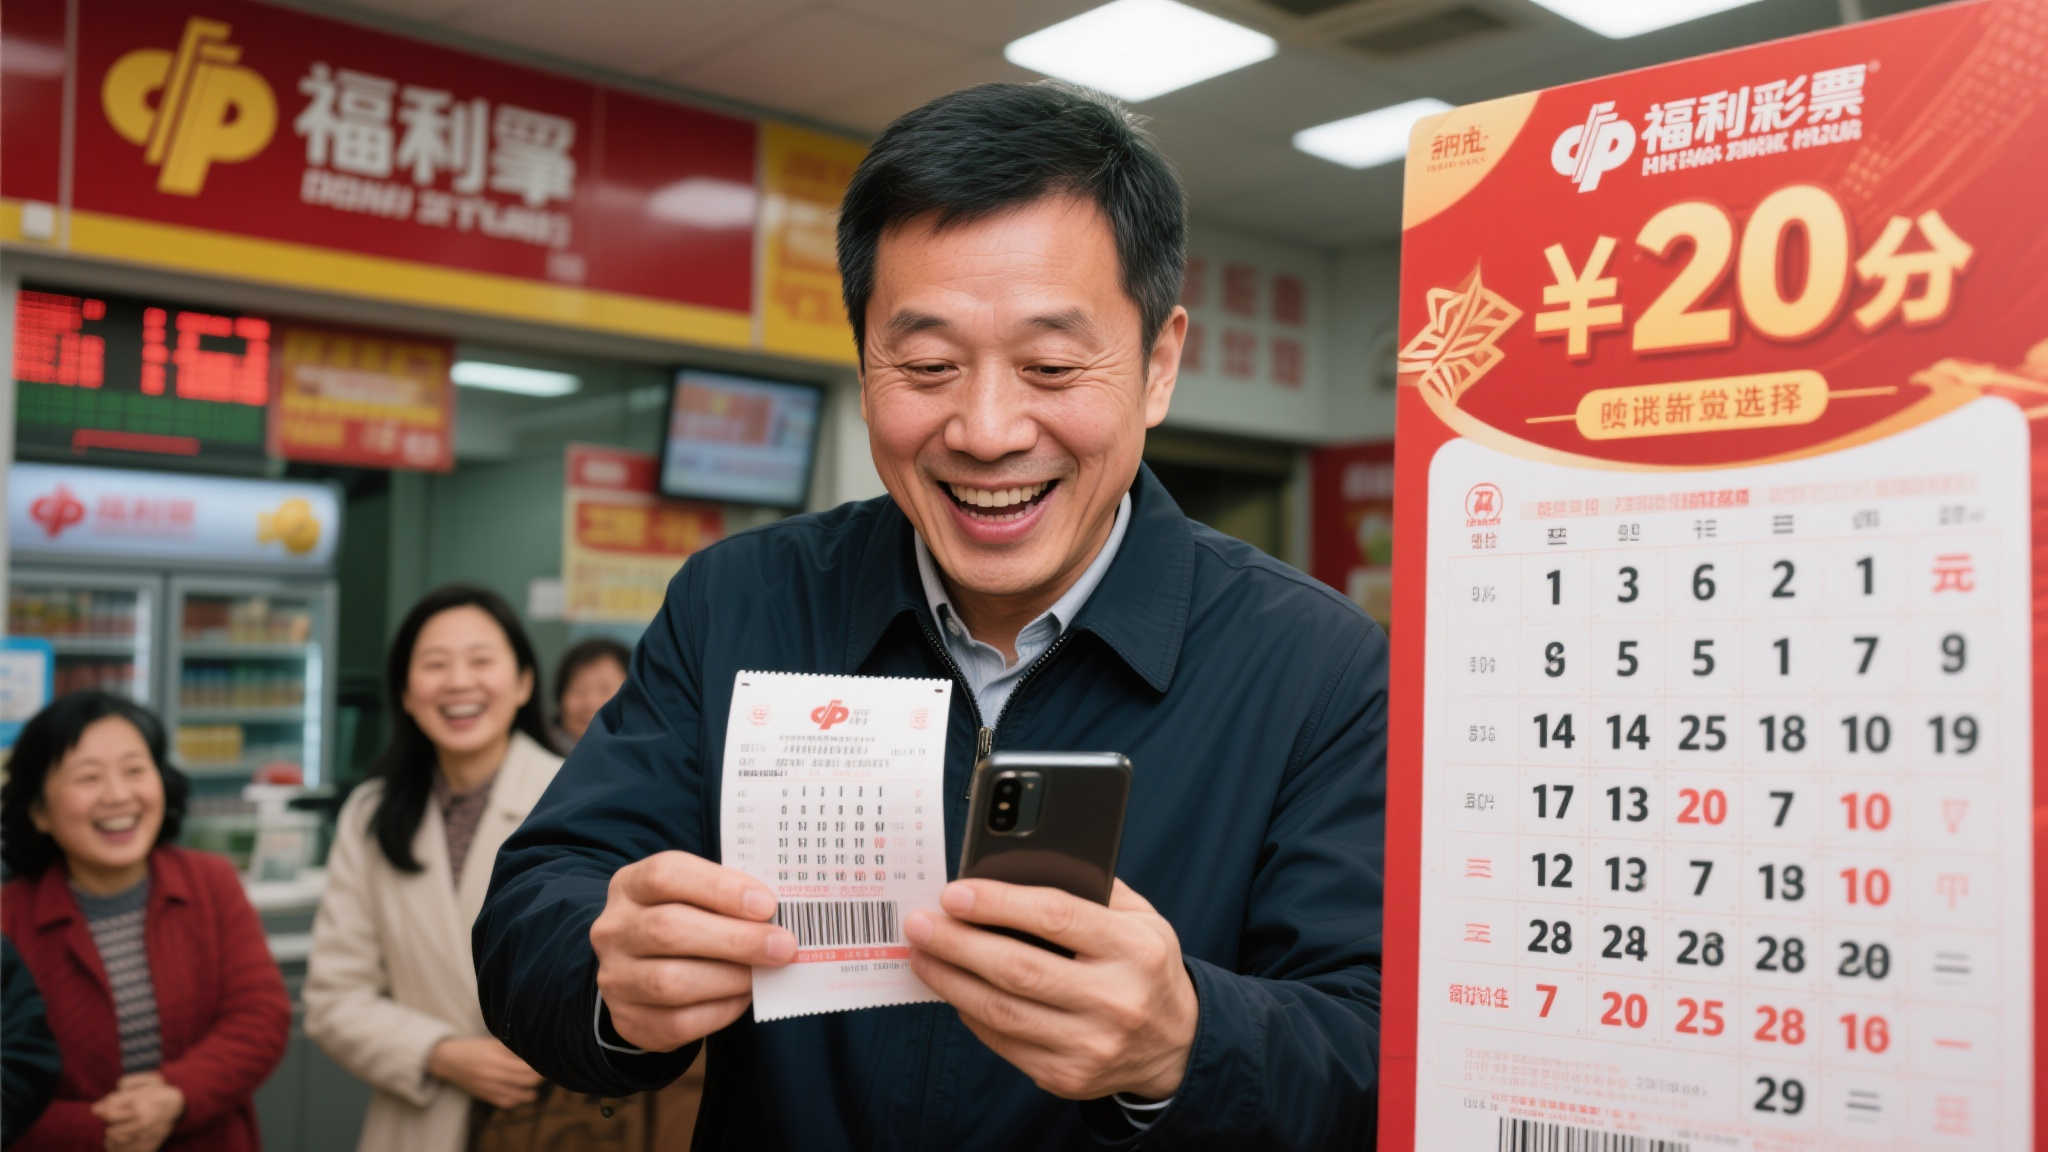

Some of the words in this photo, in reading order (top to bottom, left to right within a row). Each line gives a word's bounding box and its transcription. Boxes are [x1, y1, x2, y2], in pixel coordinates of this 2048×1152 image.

[1641, 63, 1868, 155] 福利彩票
[1546, 569, 1561, 606] 1
[1617, 566, 1639, 604] 3
[1692, 563, 1716, 602] 6
[1771, 559, 1796, 599] 2
[1856, 556, 1874, 596] 1
[1932, 553, 1975, 593] 元
[1616, 640, 1639, 678] 5
[1692, 639, 1715, 677] 5
[1773, 637, 1790, 676] 1
[1853, 636, 1879, 675] 7
[1940, 632, 1967, 675] 9
[1533, 713, 1576, 749] 14
[1606, 714, 1651, 751] 14
[1678, 714, 1727, 752] 25
[1759, 714, 1807, 753] 18
[1841, 715, 1892, 754] 10
[1928, 714, 1980, 755] 19
[1532, 783, 1574, 820] 17
[1606, 786, 1649, 823] 13
[1676, 788, 1728, 826] 20
[1769, 791, 1795, 828] 7
[1839, 792, 1892, 832] 10
[1532, 852, 1573, 889] 12
[1605, 856, 1647, 893] 13
[1689, 860, 1714, 896] 7
[1839, 867, 1892, 907] 10
[1527, 918, 1573, 955] 28
[1755, 935, 1806, 974] 28
[1535, 983, 1558, 1018] 7
[1600, 991, 1649, 1029] 20
[1675, 997, 1725, 1037] 25
[1753, 1004, 1806, 1046] 28
[1753, 1076, 1806, 1116] 29
